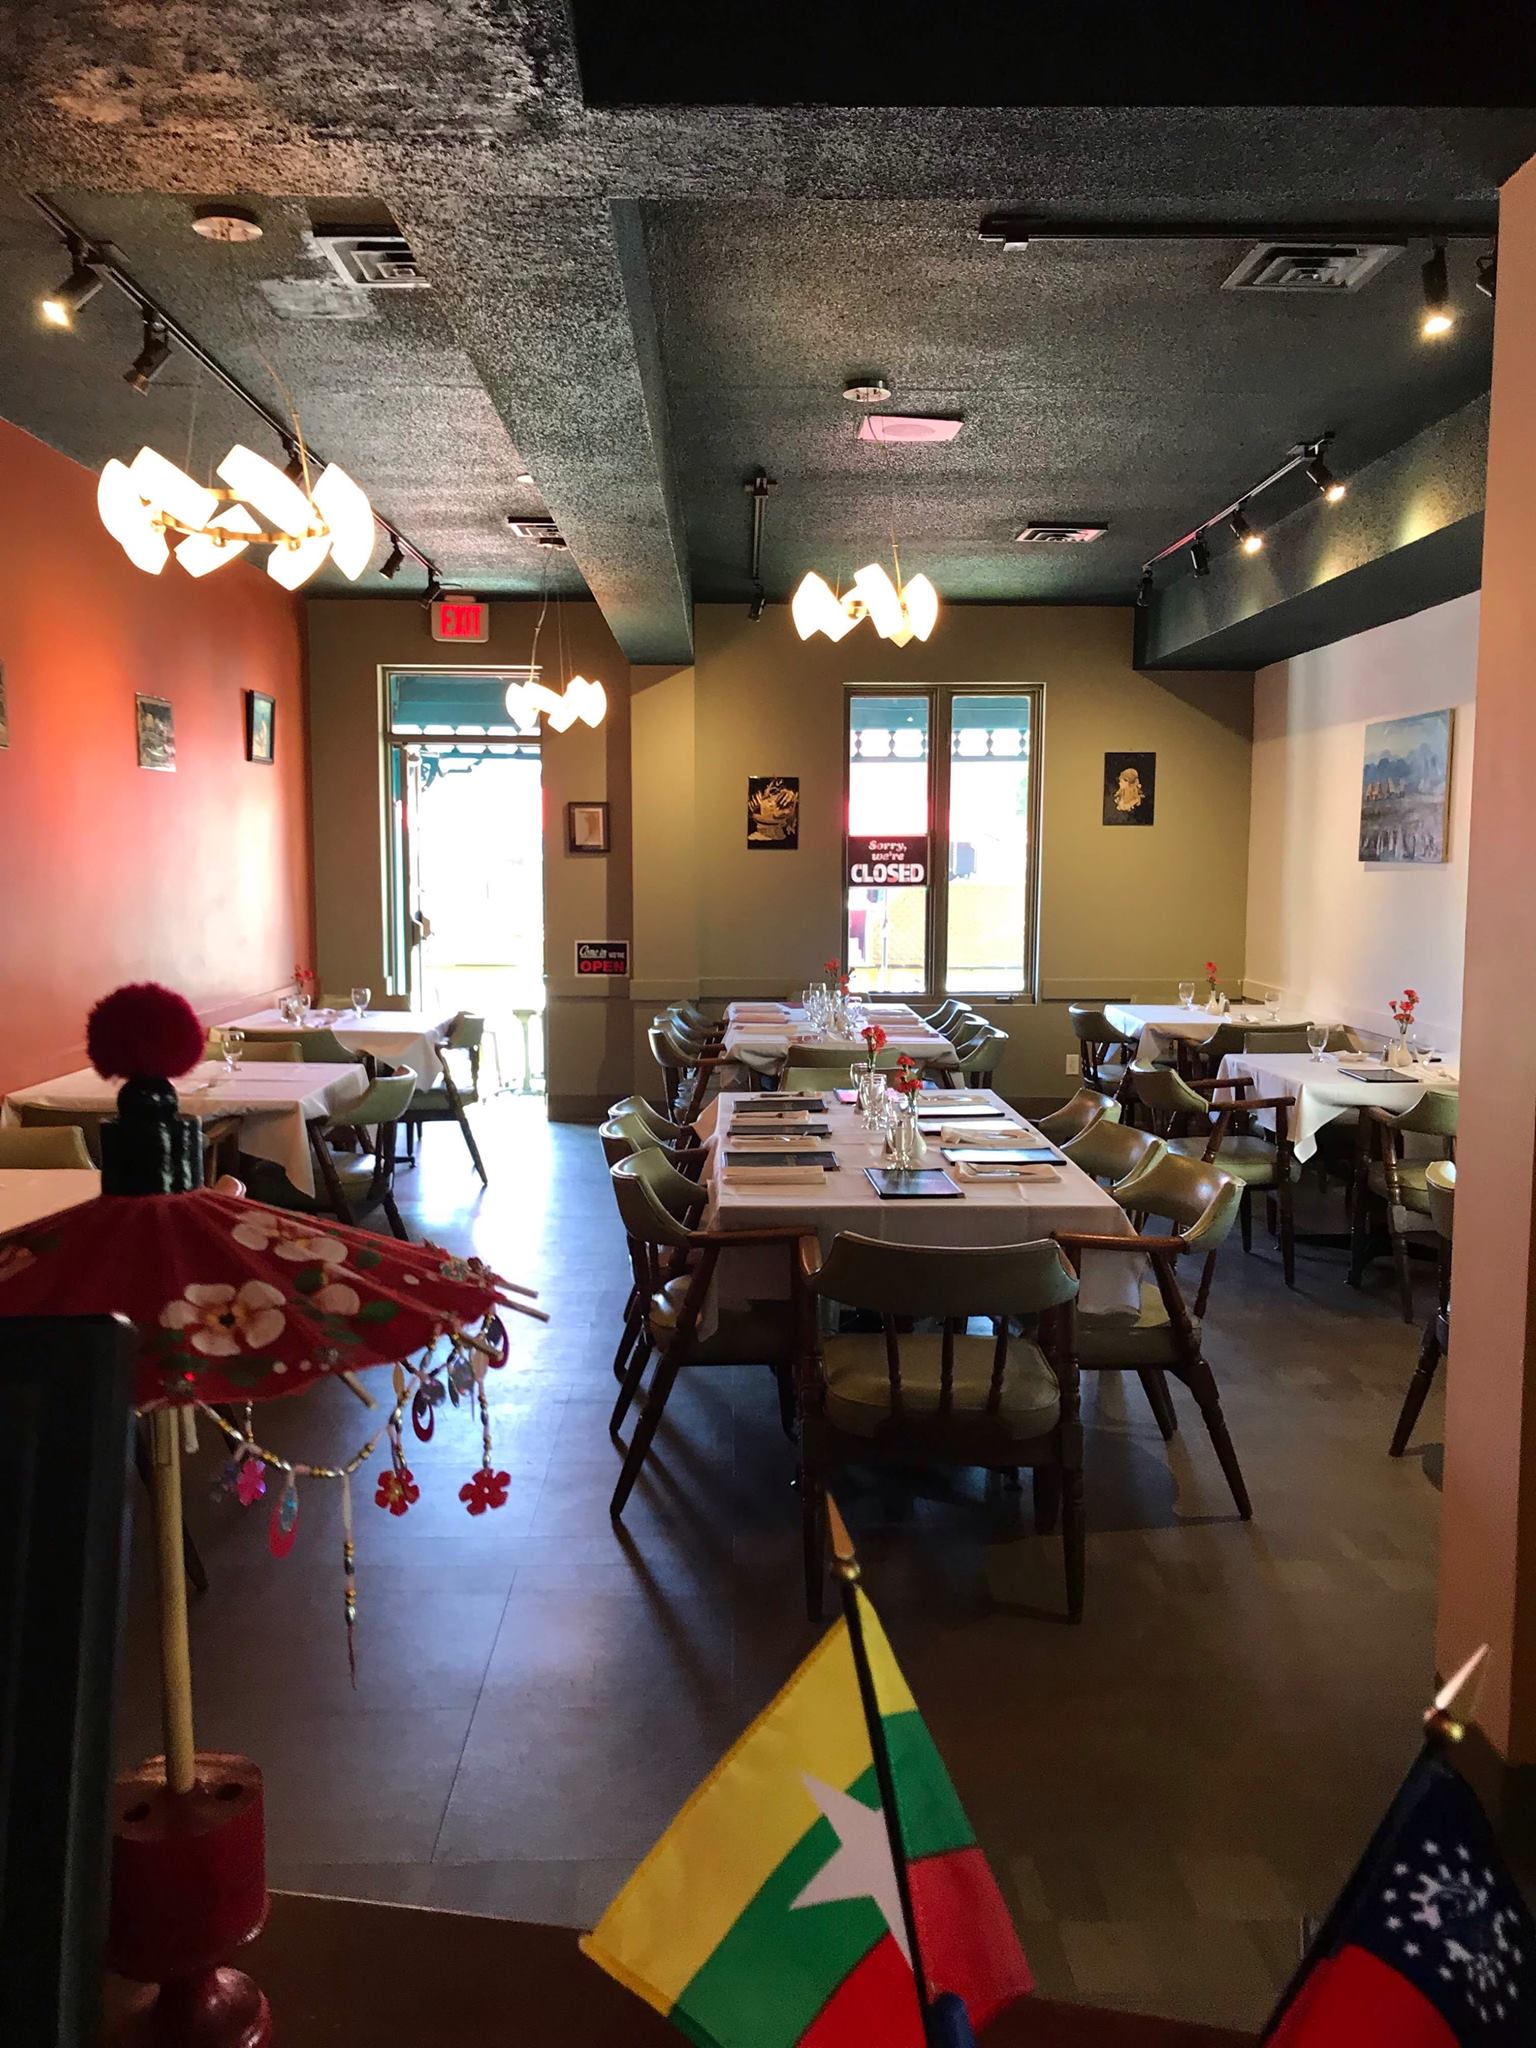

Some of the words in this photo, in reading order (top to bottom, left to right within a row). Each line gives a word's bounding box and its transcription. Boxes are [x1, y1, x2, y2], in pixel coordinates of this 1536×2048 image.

[440, 605, 482, 637] EXIT
[868, 840, 908, 852] Sorry,
[871, 851, 905, 861] we're
[850, 863, 925, 883] CLOSED
[580, 960, 625, 972] OPEN
